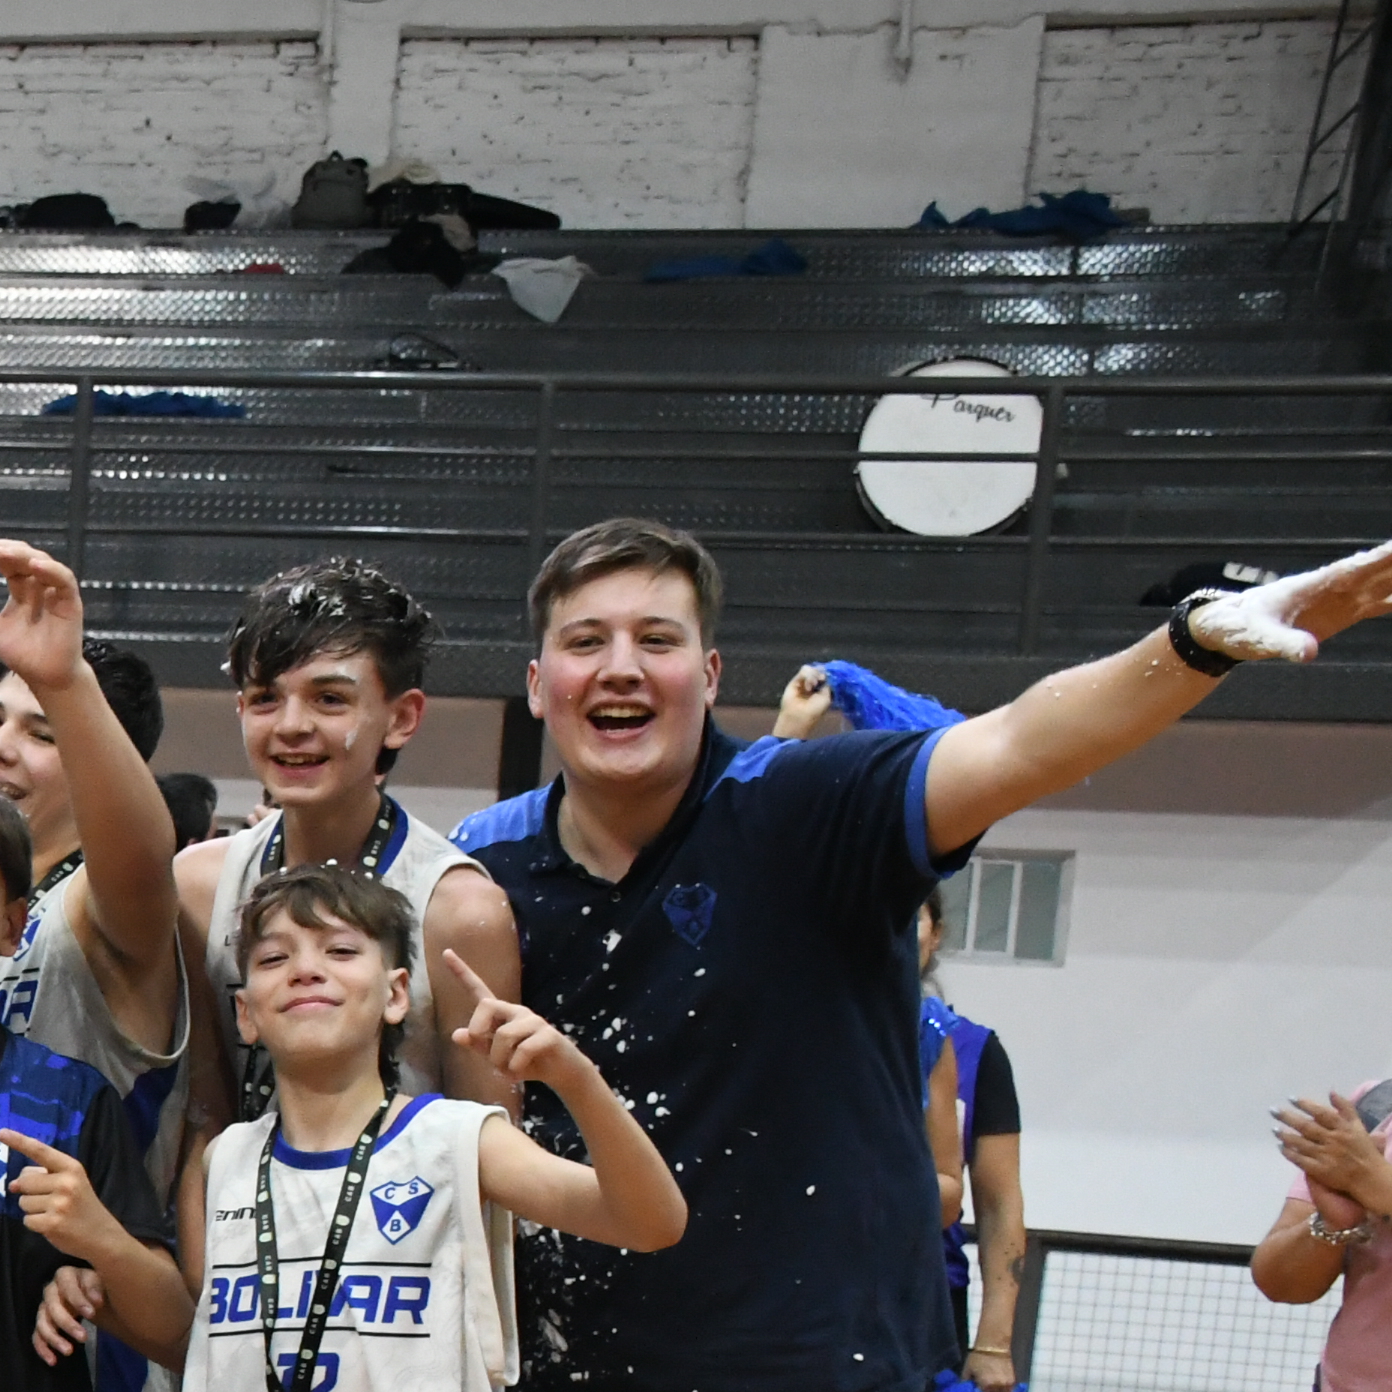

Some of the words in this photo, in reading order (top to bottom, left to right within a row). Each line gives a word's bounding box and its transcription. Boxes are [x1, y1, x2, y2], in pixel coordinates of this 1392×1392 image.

[384, 1186, 396, 1200] C
[408, 1181, 419, 1195] S
[389, 1218, 402, 1233] B
